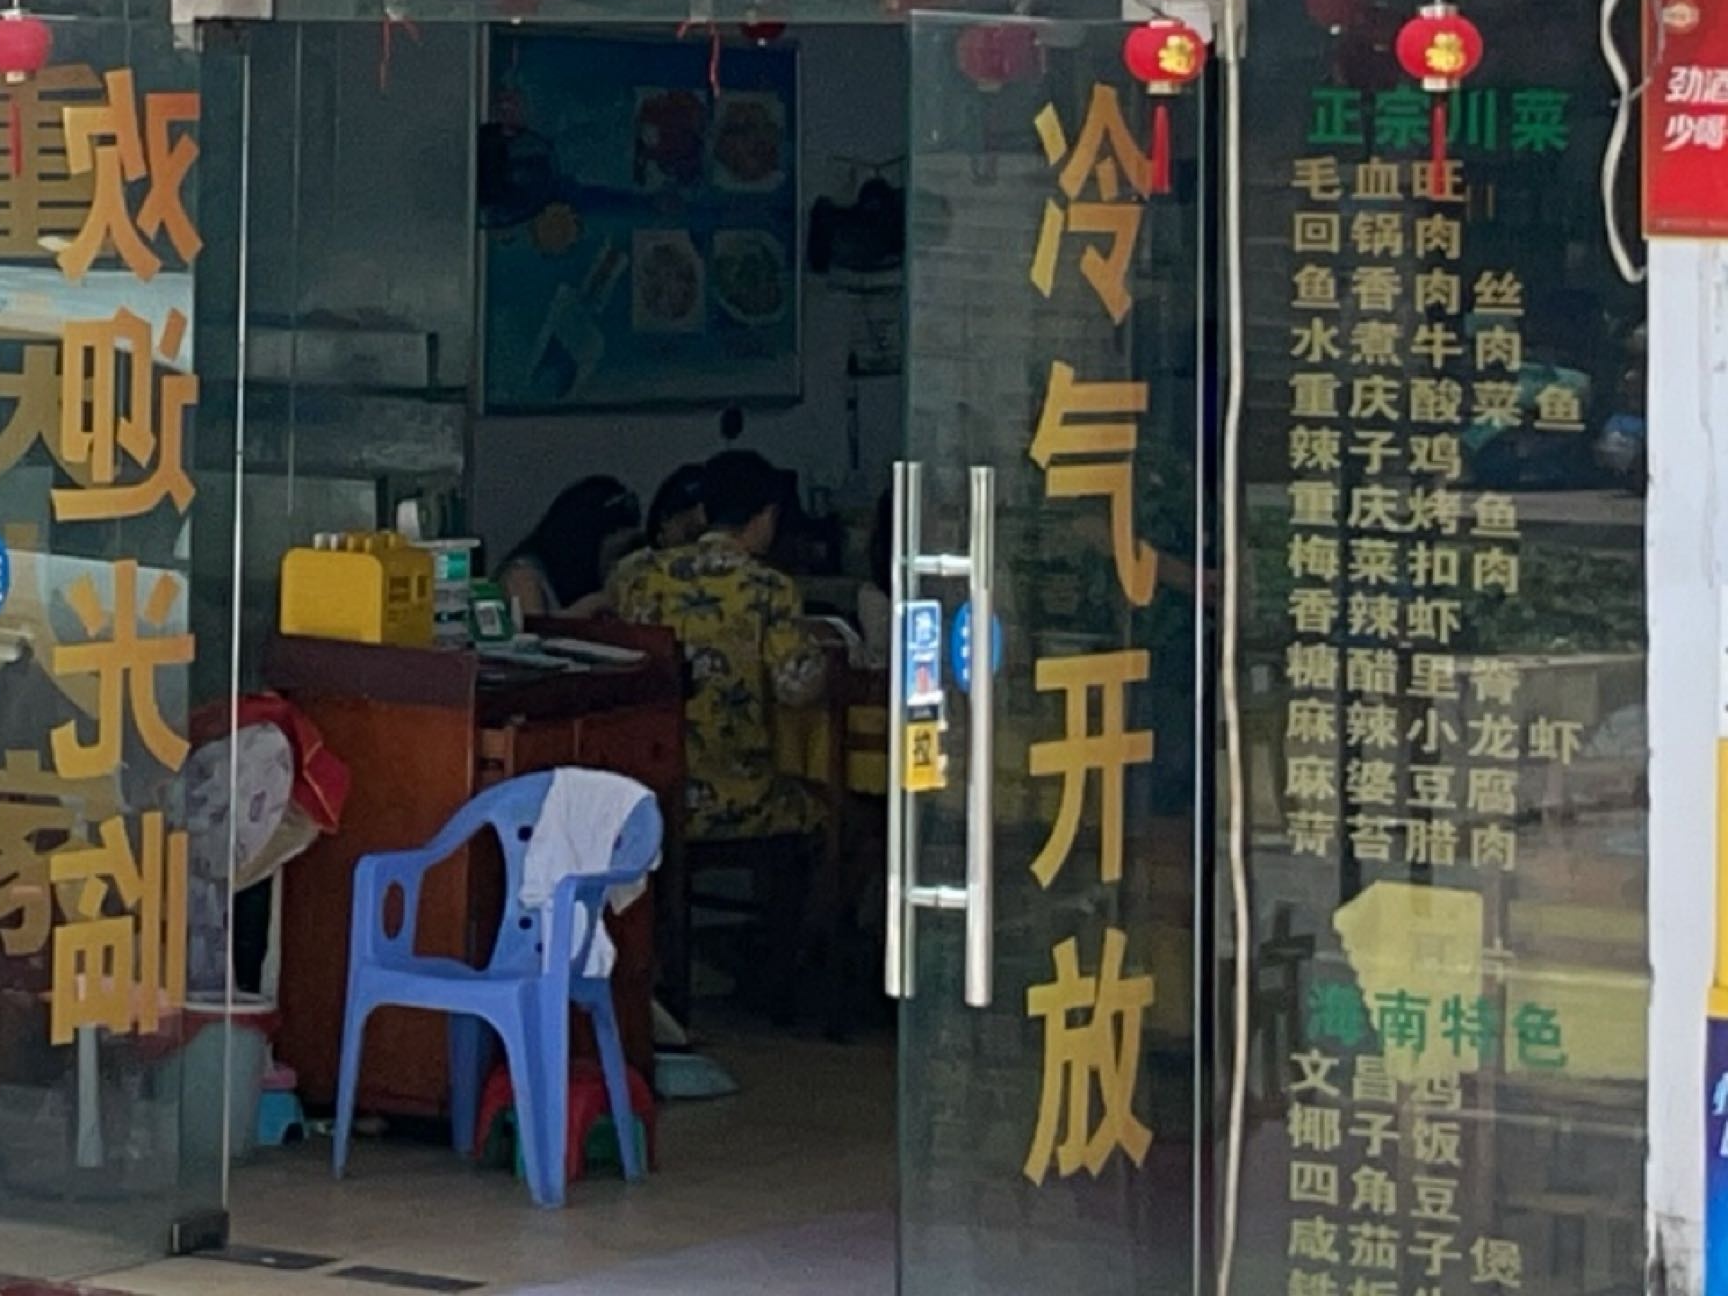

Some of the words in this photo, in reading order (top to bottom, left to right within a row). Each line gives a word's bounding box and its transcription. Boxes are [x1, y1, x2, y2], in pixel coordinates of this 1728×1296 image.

[1307, 85, 1571, 151] 正宗川菜
[1291, 156, 1466, 202] 毛血旺
[1293, 212, 1463, 259] 回锅肉
[1291, 265, 1525, 316] 鱼香肉丝
[1290, 318, 1522, 371] 水煮牛肉
[1288, 372, 1586, 431] 重庆酸菜鱼
[1287, 424, 1463, 480] 辣子鸡
[1287, 481, 1520, 540] 重庆烤鱼
[1286, 534, 1520, 594] 梅菜扣肉
[1023, 82, 1157, 1186] 冷气开放
[1286, 588, 1462, 644] 香辣虾
[1285, 641, 1520, 705] 糖醋里脊
[1285, 698, 1584, 764] 麻辣小龙虾
[1284, 755, 1518, 815] 麻婆豆腐
[1305, 982, 1569, 1068] 海南特色
[1287, 1102, 1463, 1169] 椰子饭
[1288, 1160, 1462, 1223] 四角豆
[1287, 1215, 1522, 1289] 咸茄子煲
